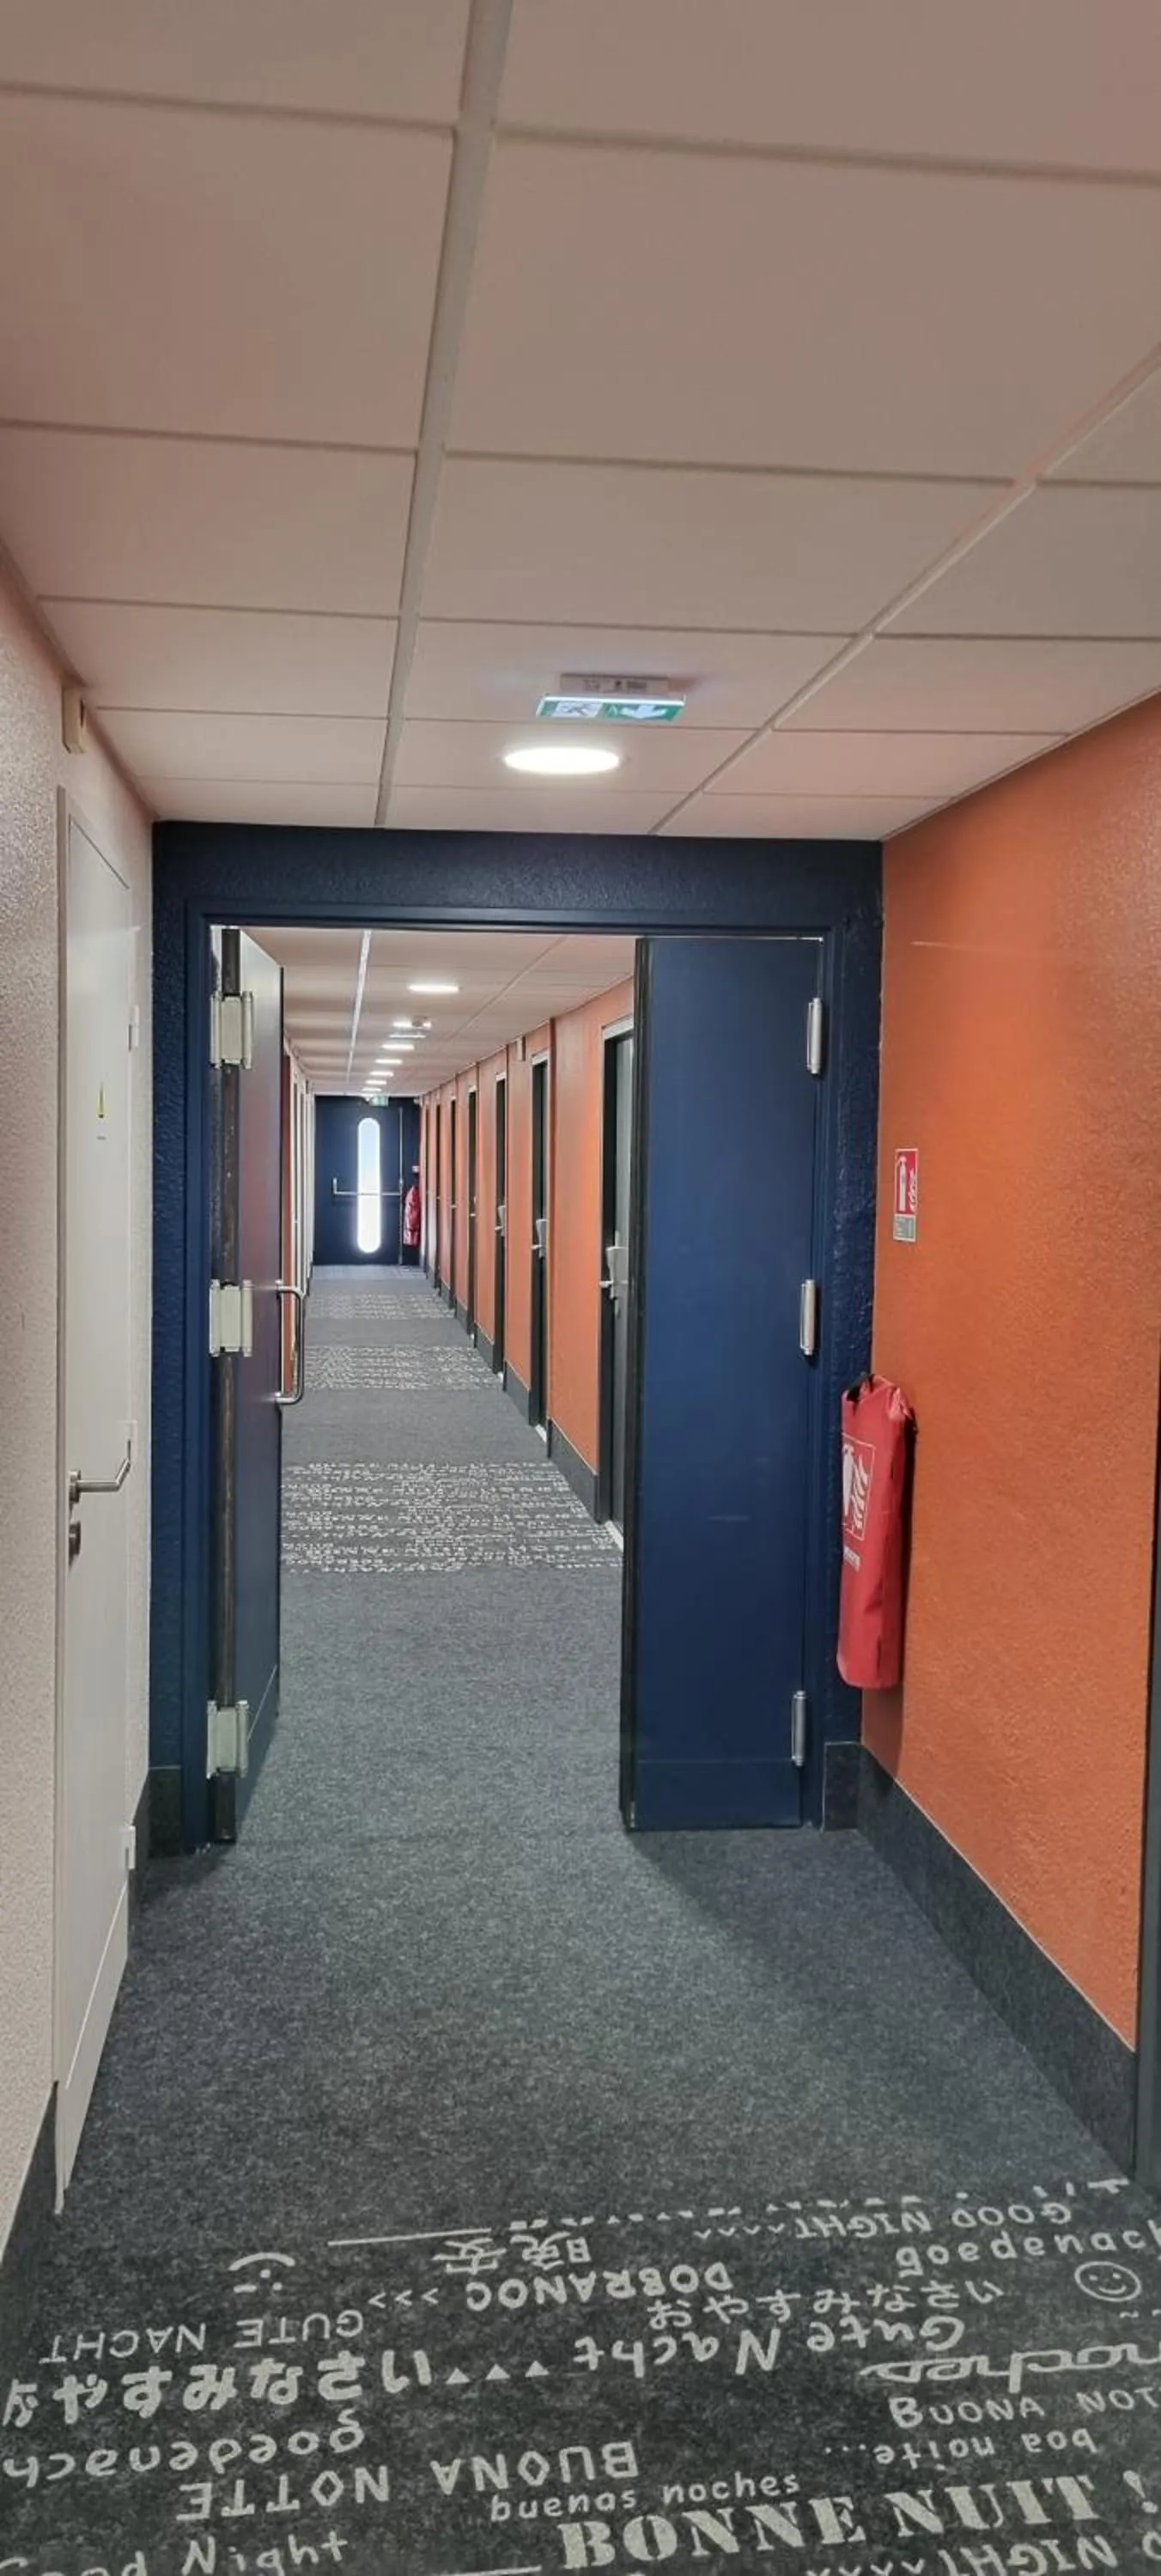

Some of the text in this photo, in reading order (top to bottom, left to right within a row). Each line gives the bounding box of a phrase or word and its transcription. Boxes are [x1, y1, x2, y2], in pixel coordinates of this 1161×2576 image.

[795, 2209, 931, 2239] NIGHT
[951, 2202, 1071, 2228] GOOD
[465, 2261, 732, 2312] DOBRANOC
[647, 2280, 1003, 2330] おやすみなさい
[39, 2309, 363, 2363] GUTE NACHT
[573, 2315, 964, 2378] Gute Nacht
[888, 2387, 1161, 2428] BUONA NOT
[824, 2428, 1097, 2472] boa noite...
[176, 2441, 639, 2520] BUONA NOTTE
[489, 2470, 799, 2523] buenas noches
[557, 2470, 1158, 2570] BONNE NUIT !
[180, 2530, 348, 2576] Night
